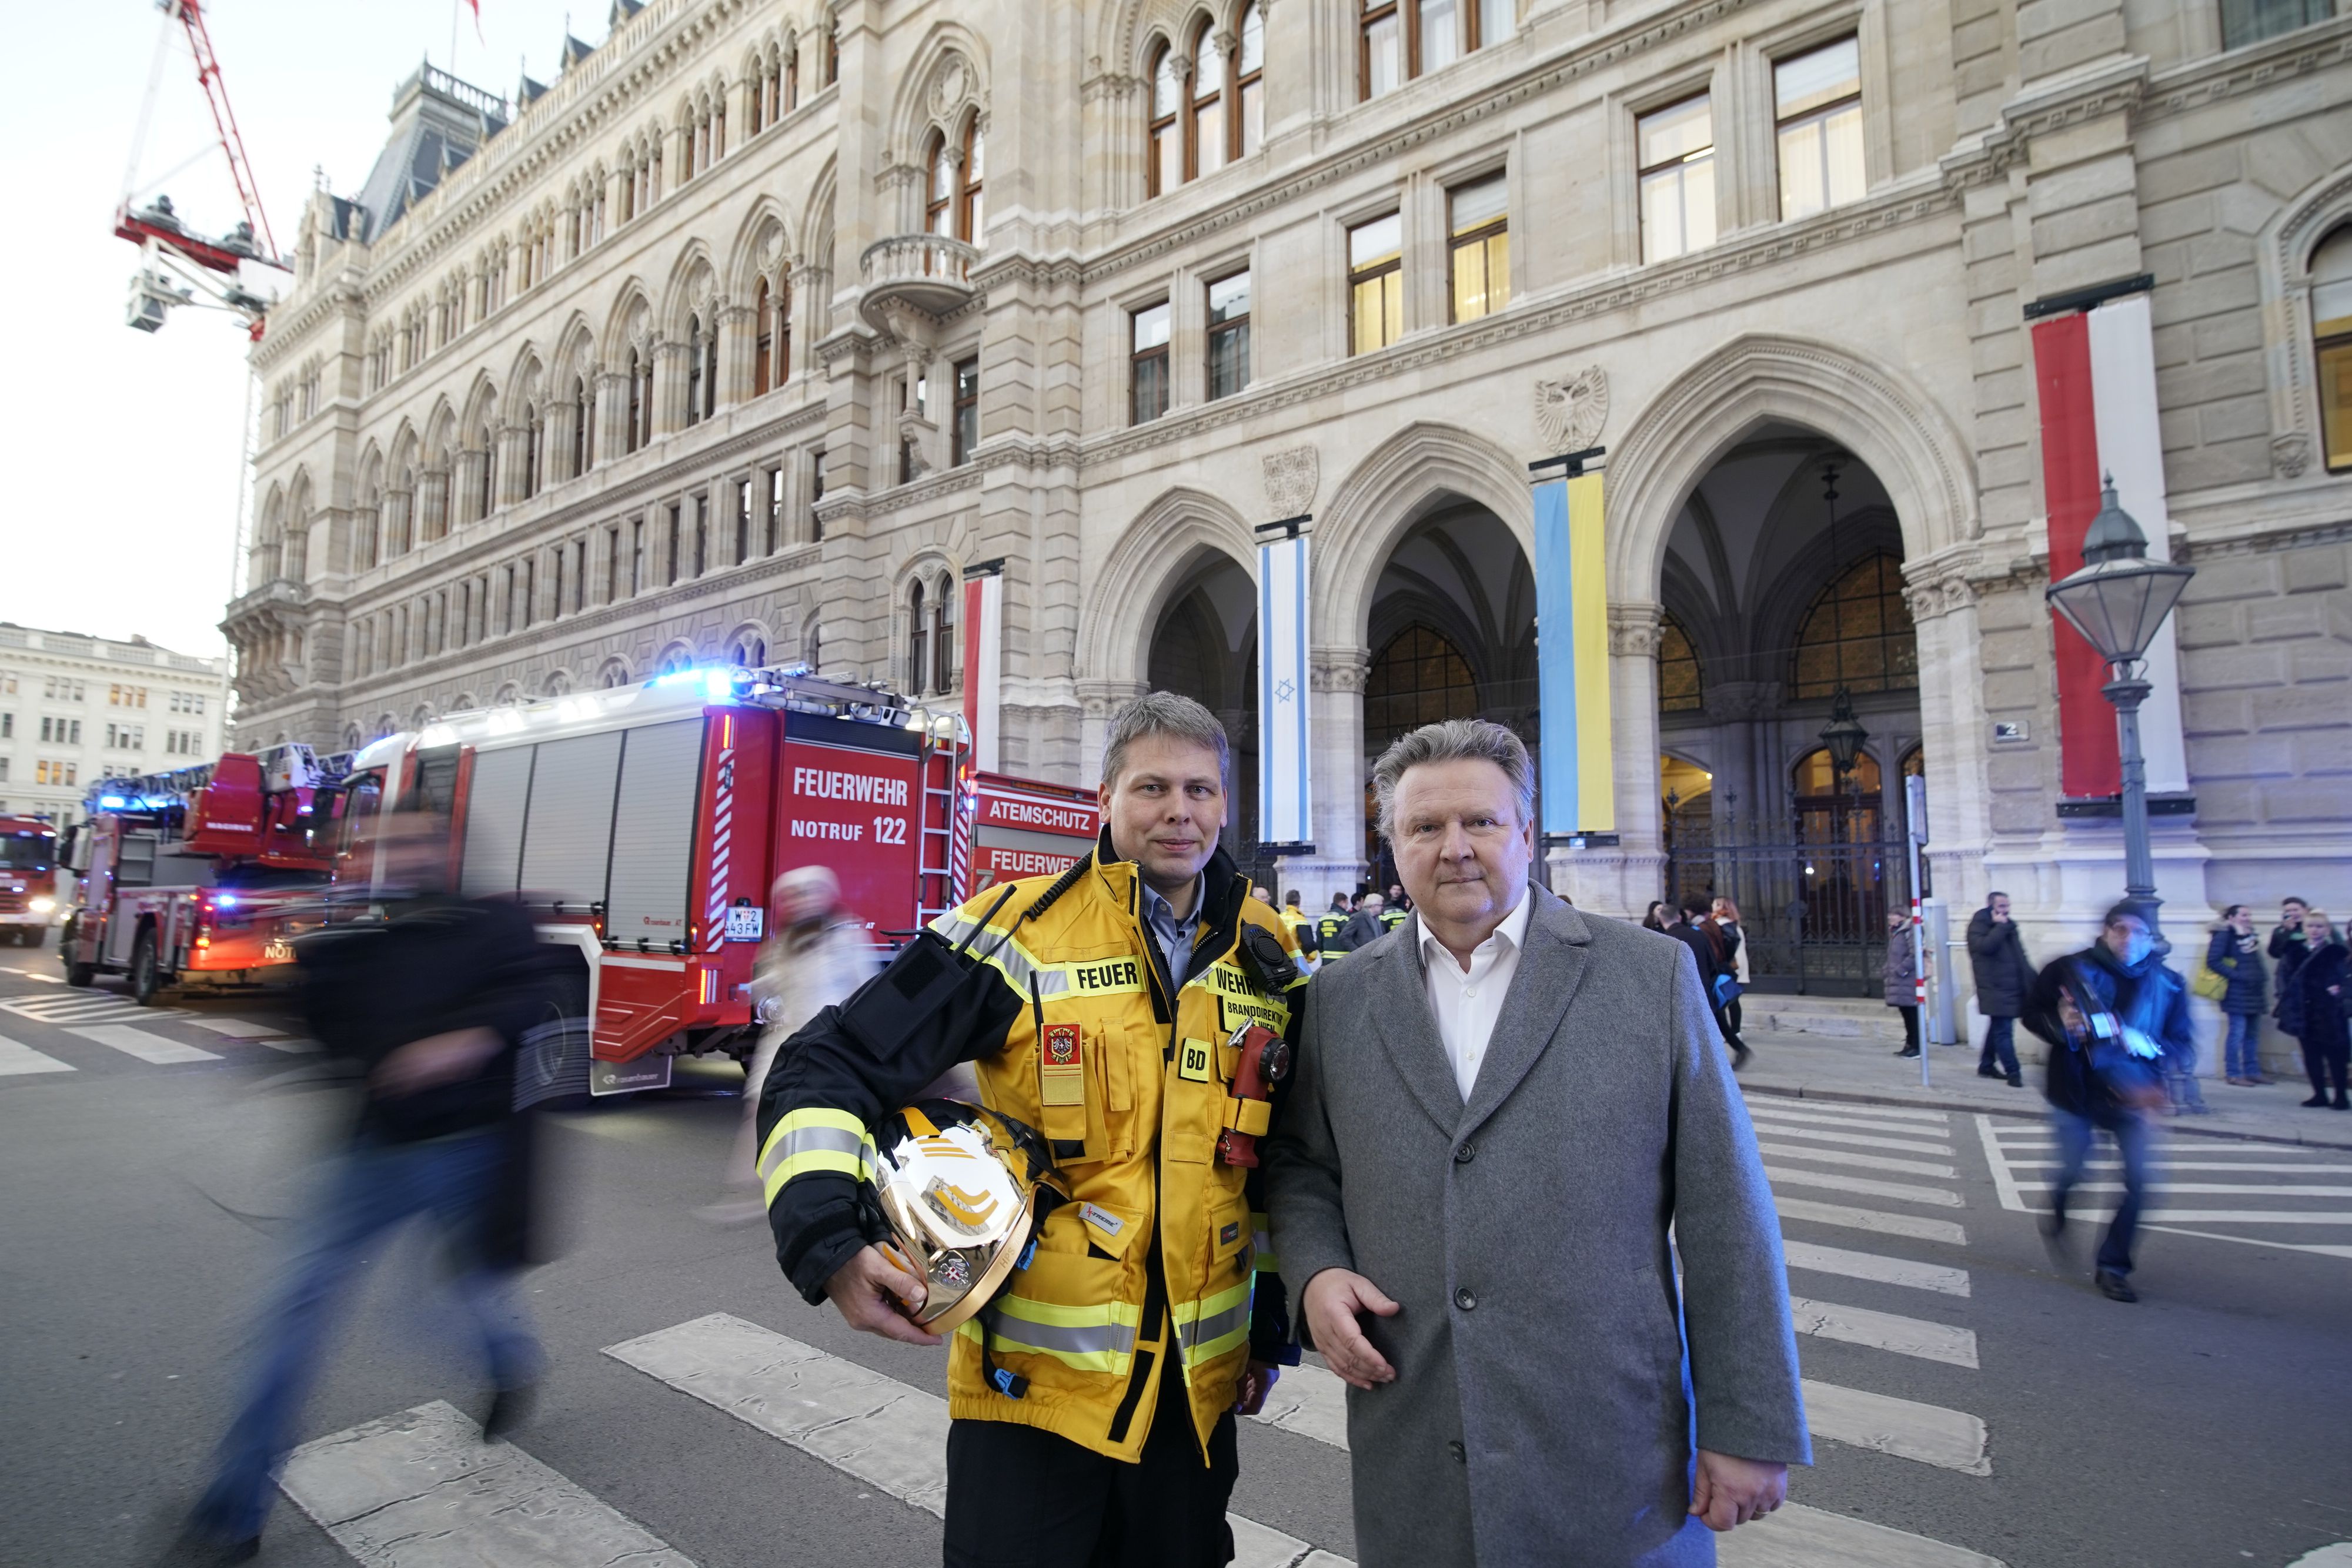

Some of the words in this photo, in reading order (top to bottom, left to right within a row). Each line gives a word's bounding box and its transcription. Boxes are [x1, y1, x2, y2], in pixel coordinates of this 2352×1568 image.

[794, 767, 908, 807] FEUERWEHR
[990, 800, 1090, 831] ATEMSCHUTZ
[791, 820, 863, 841] NOTRUF
[873, 816, 906, 845] 122
[751, 911, 756, 922] 2
[1077, 962, 1138, 989] FEUER
[1216, 967, 1257, 997] WEHR
[1187, 1048, 1205, 1071] BD
[1000, 1247, 1015, 1269] HPS
